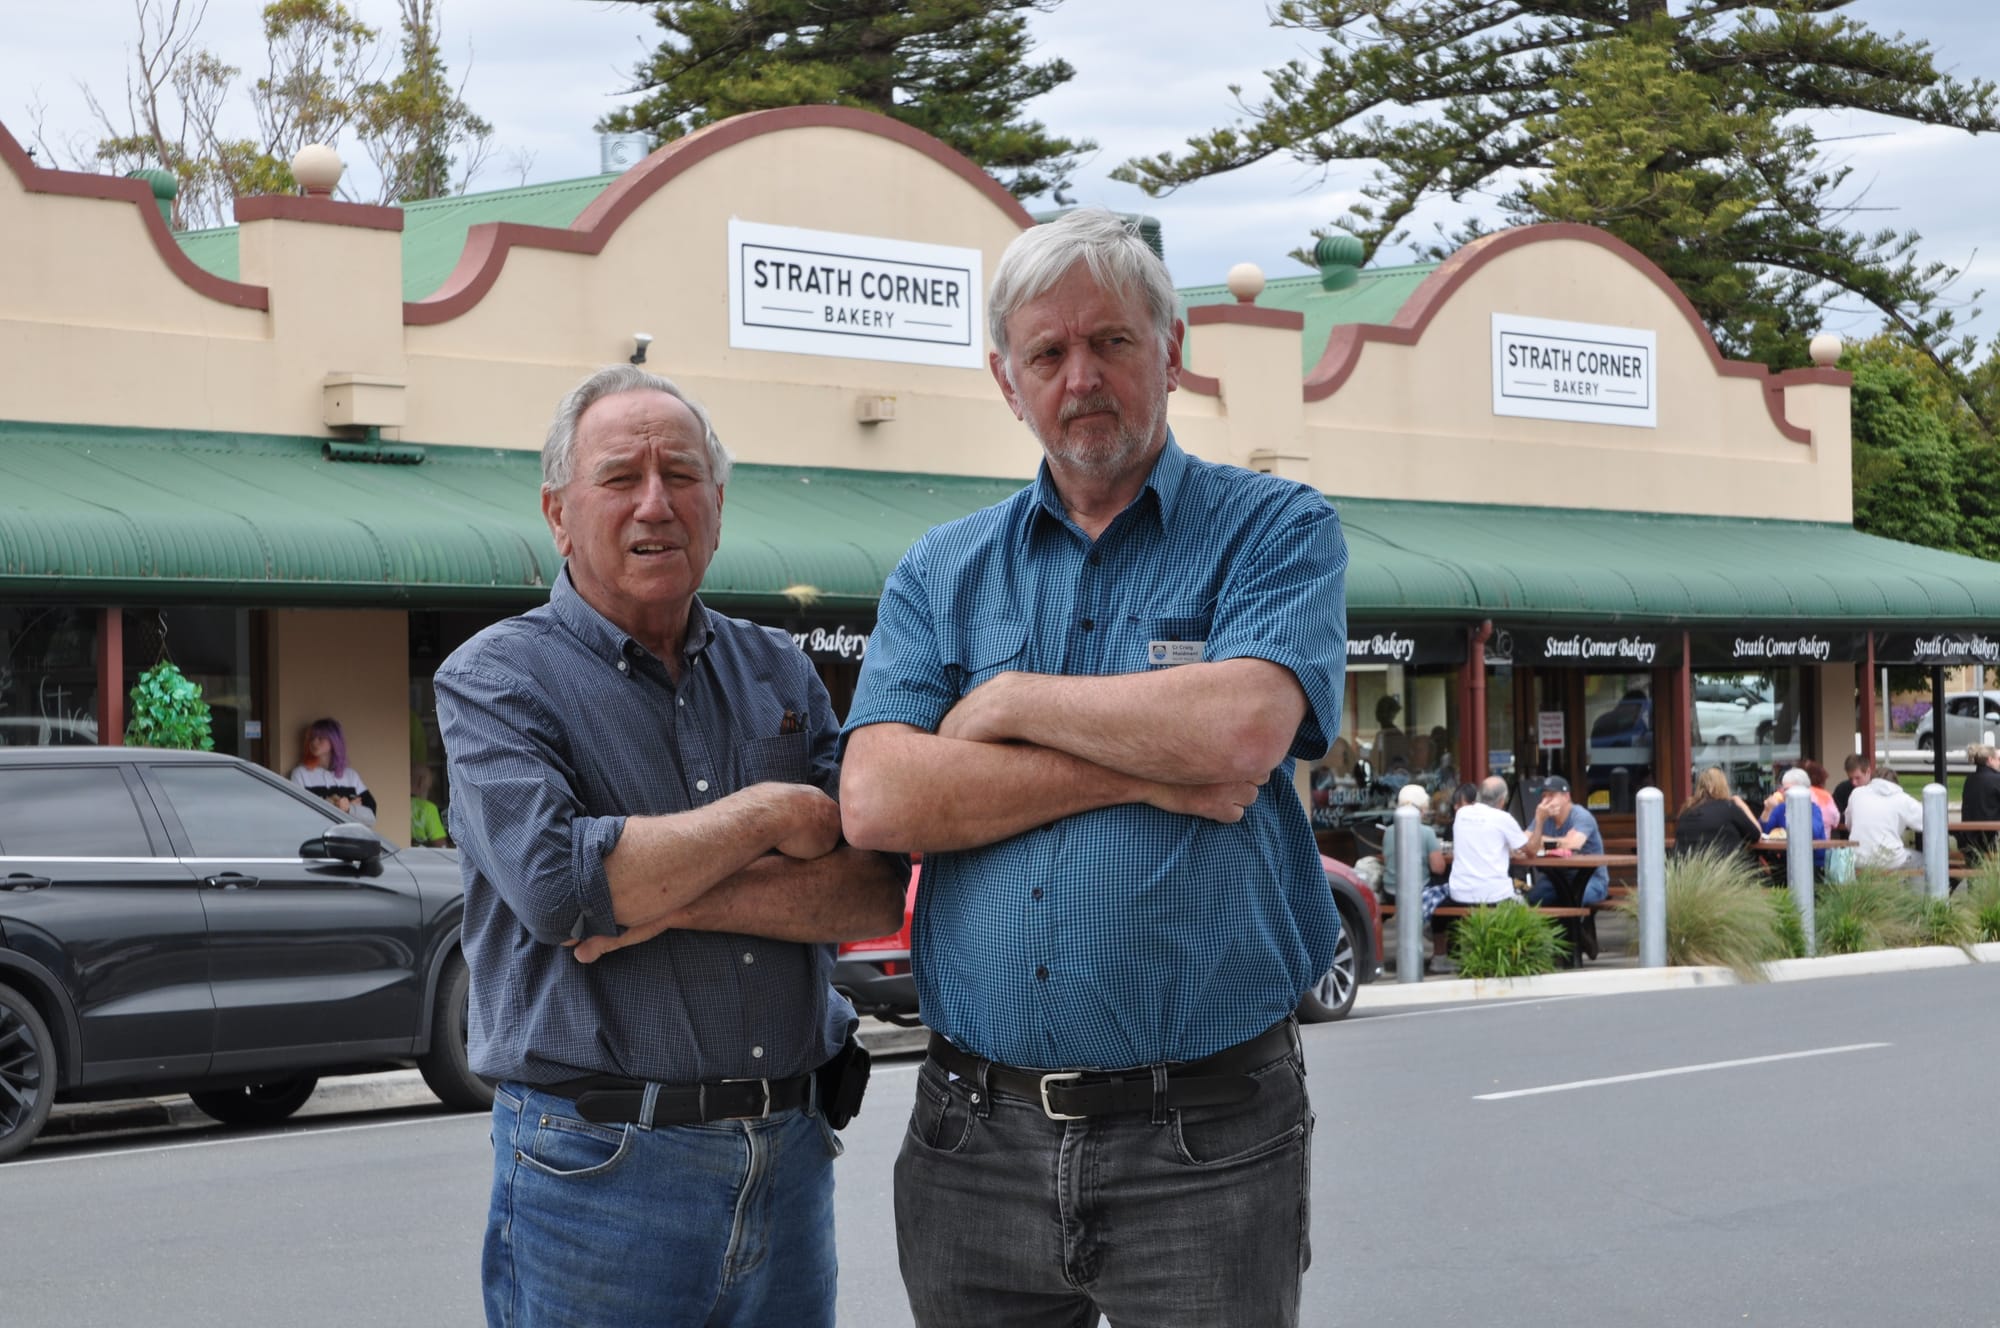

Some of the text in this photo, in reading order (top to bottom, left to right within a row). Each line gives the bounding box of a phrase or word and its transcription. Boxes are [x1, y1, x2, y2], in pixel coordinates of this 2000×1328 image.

[754, 259, 960, 308] STRATH CORNER
[824, 306, 895, 328] BAKERY
[1508, 344, 1642, 379] STRATH CORNER
[1553, 379, 1599, 396] BAKERY
[810, 625, 869, 660] Bakery
[1346, 632, 1415, 661] rner Bakery
[1544, 634, 1656, 663] Strath Corner Bakery
[1733, 635, 1830, 660] Strath Corner Bakery
[1913, 635, 1999, 661] Strath Corner Bakery
